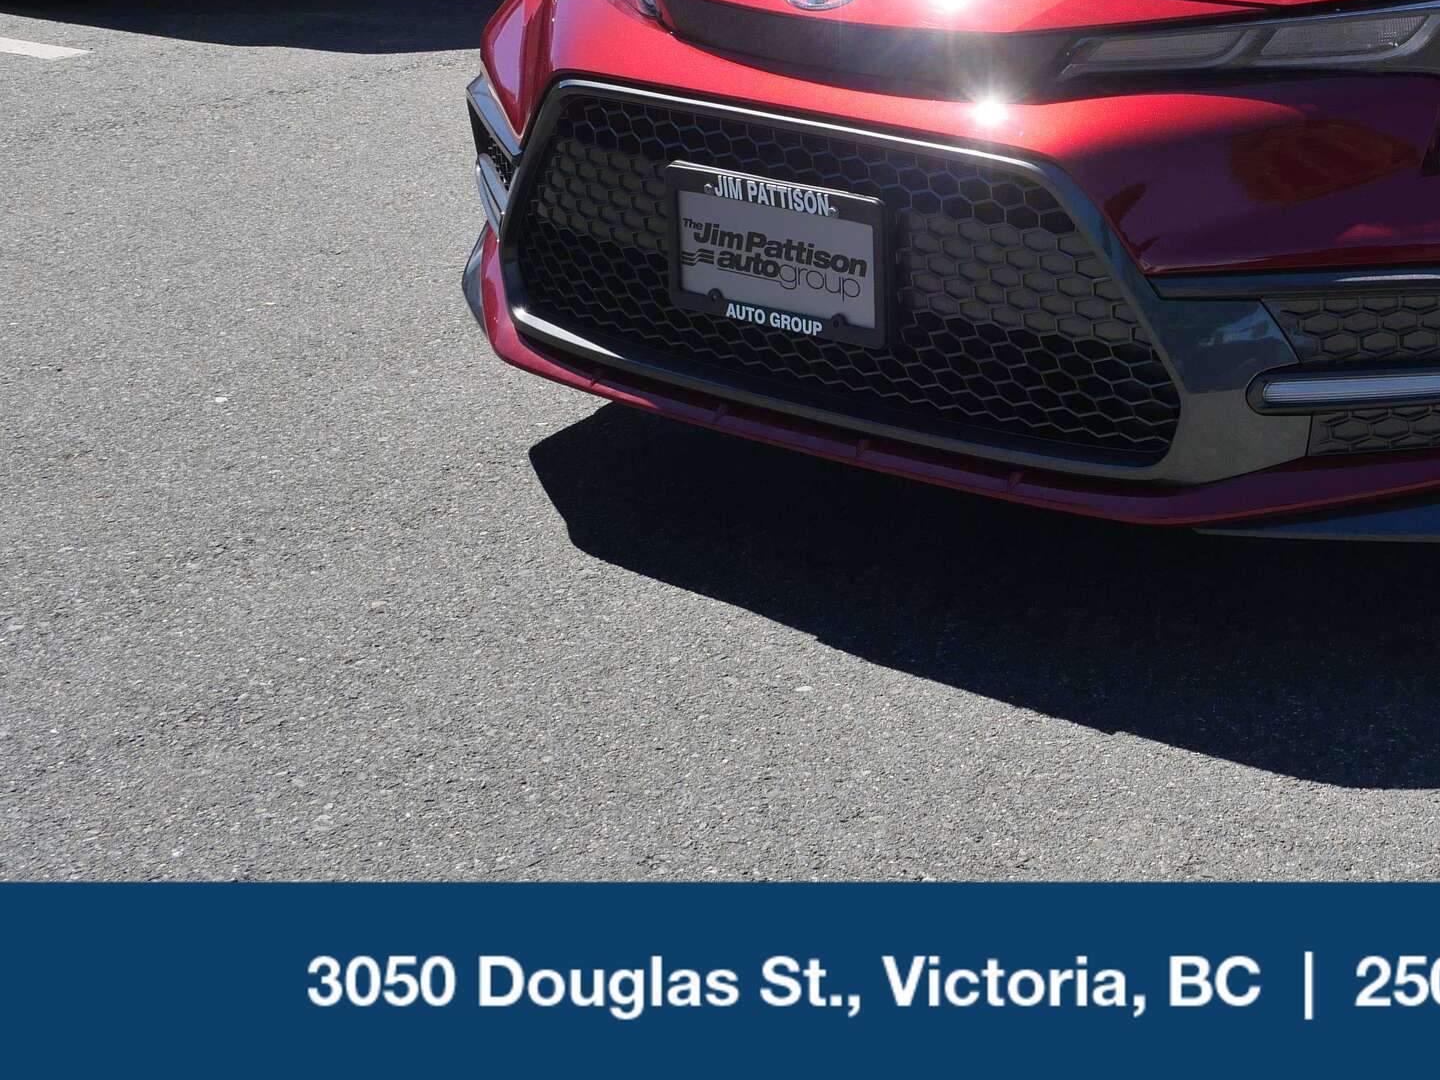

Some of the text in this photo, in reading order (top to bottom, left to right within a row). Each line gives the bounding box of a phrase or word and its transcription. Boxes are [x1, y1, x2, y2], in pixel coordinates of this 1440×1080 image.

[715, 174, 829, 217] JIM PATTISON
[683, 218, 867, 278] The Jim Pattison
[726, 303, 823, 336] AUTO GROUP
